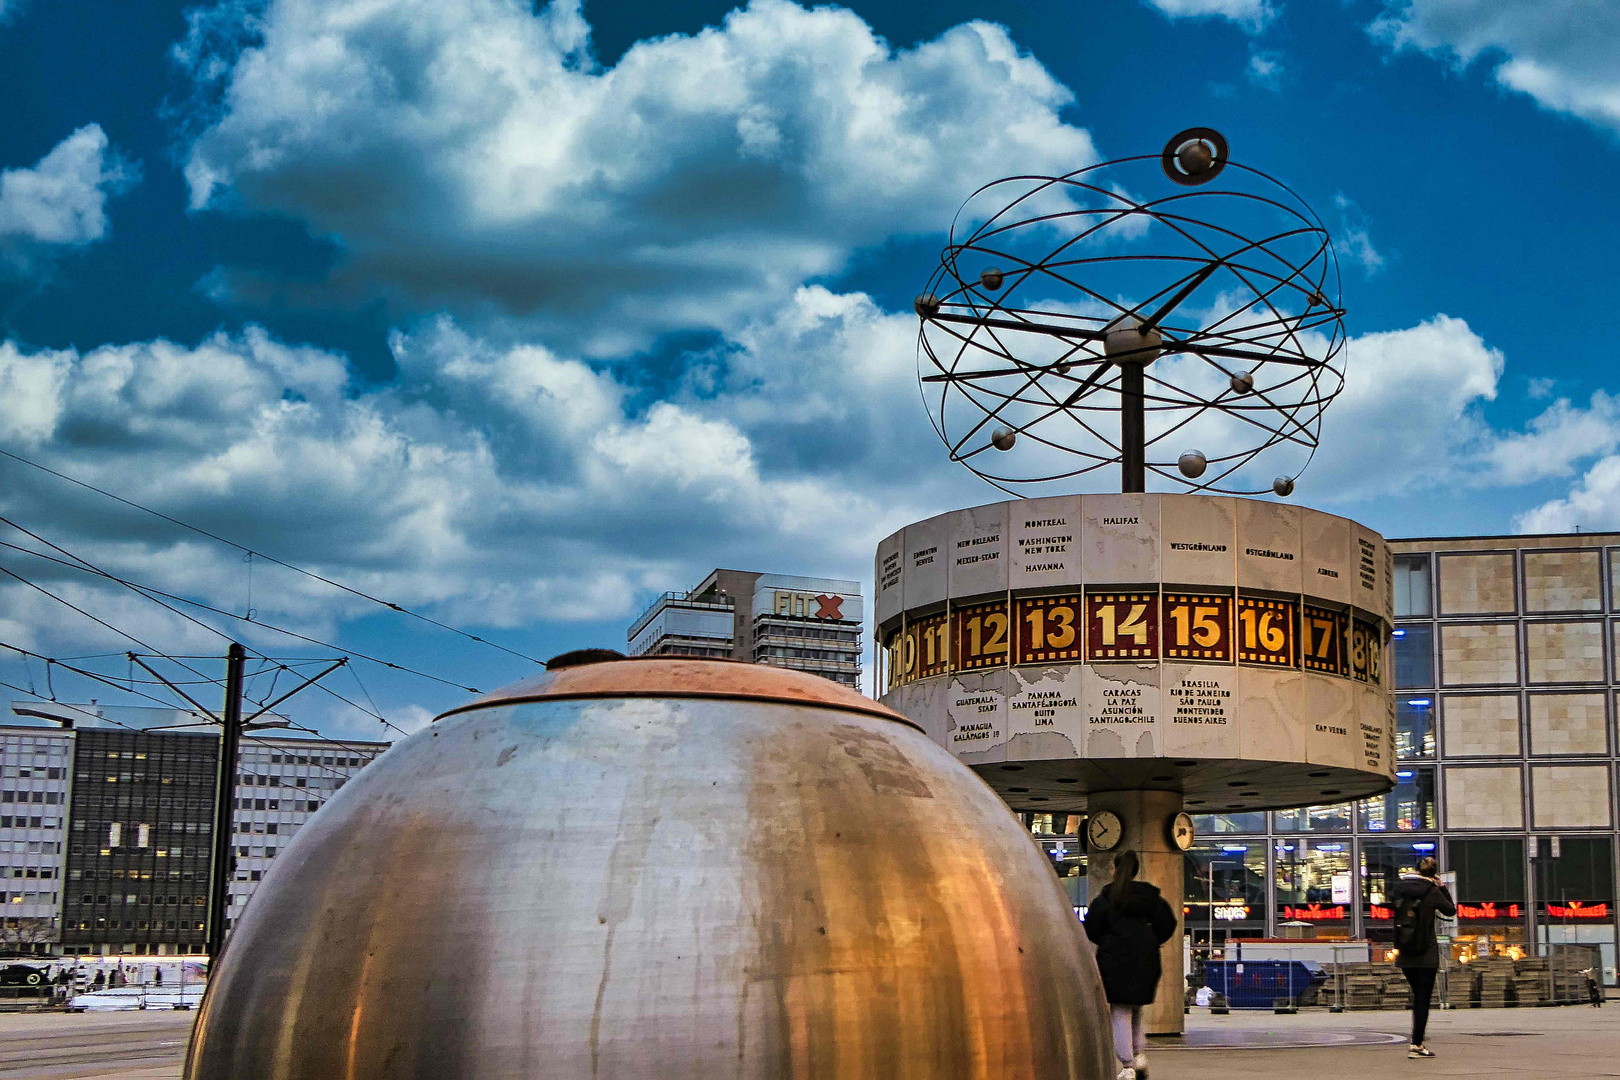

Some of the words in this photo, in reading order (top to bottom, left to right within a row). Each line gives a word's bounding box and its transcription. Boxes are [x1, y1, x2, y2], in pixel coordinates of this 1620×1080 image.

[1025, 518, 1067, 529] MONTREAL
[1103, 517, 1139, 525] HALIFAX
[957, 541, 970, 549] NEW
[972, 535, 1000, 546] ORLEANS
[1018, 535, 1073, 547] WASHINGTON
[1025, 546, 1042, 555] NEW
[1045, 545, 1066, 554] YORK
[1170, 542, 1227, 552] WESTGRÖNLAND
[956, 552, 1000, 566] MEXIKO-STADT
[1245, 548, 1293, 561] OSTGRÖNLAND
[1025, 562, 1065, 573] HAVANNA
[1026, 606, 1076, 650] 13
[1096, 604, 1148, 646] 14
[1170, 605, 1221, 648] 15
[1239, 603, 1285, 652] 16
[966, 611, 1009, 657] 12
[1303, 616, 1334, 658] 17
[924, 622, 948, 666] 11
[1343, 625, 1366, 671] 18
[1181, 680, 1220, 689] BRASILIA
[1027, 691, 1062, 700] PANAMA
[1103, 689, 1142, 697] CARACAS
[1170, 689, 1183, 697] RIO
[1185, 689, 1194, 697] DE
[1196, 690, 1231, 698] JANEIRO
[1107, 698, 1118, 706] LA
[1121, 698, 1137, 706] PAZ
[1179, 697, 1194, 706] SÃO
[978, 704, 998, 713] STADT
[1034, 709, 1055, 717] QUITO
[1101, 705, 1143, 715] ASUNCIÓN
[1176, 707, 1224, 716] MONTEVIDEO
[1035, 718, 1054, 726] LIMA
[1173, 716, 1203, 724] BUENOS
[1204, 717, 1227, 725] AIRES
[960, 722, 993, 733] MANAGUA
[1315, 724, 1327, 732] KAP
[1329, 726, 1347, 736] VERDE
[953, 731, 990, 742] GALÁPAGOS
